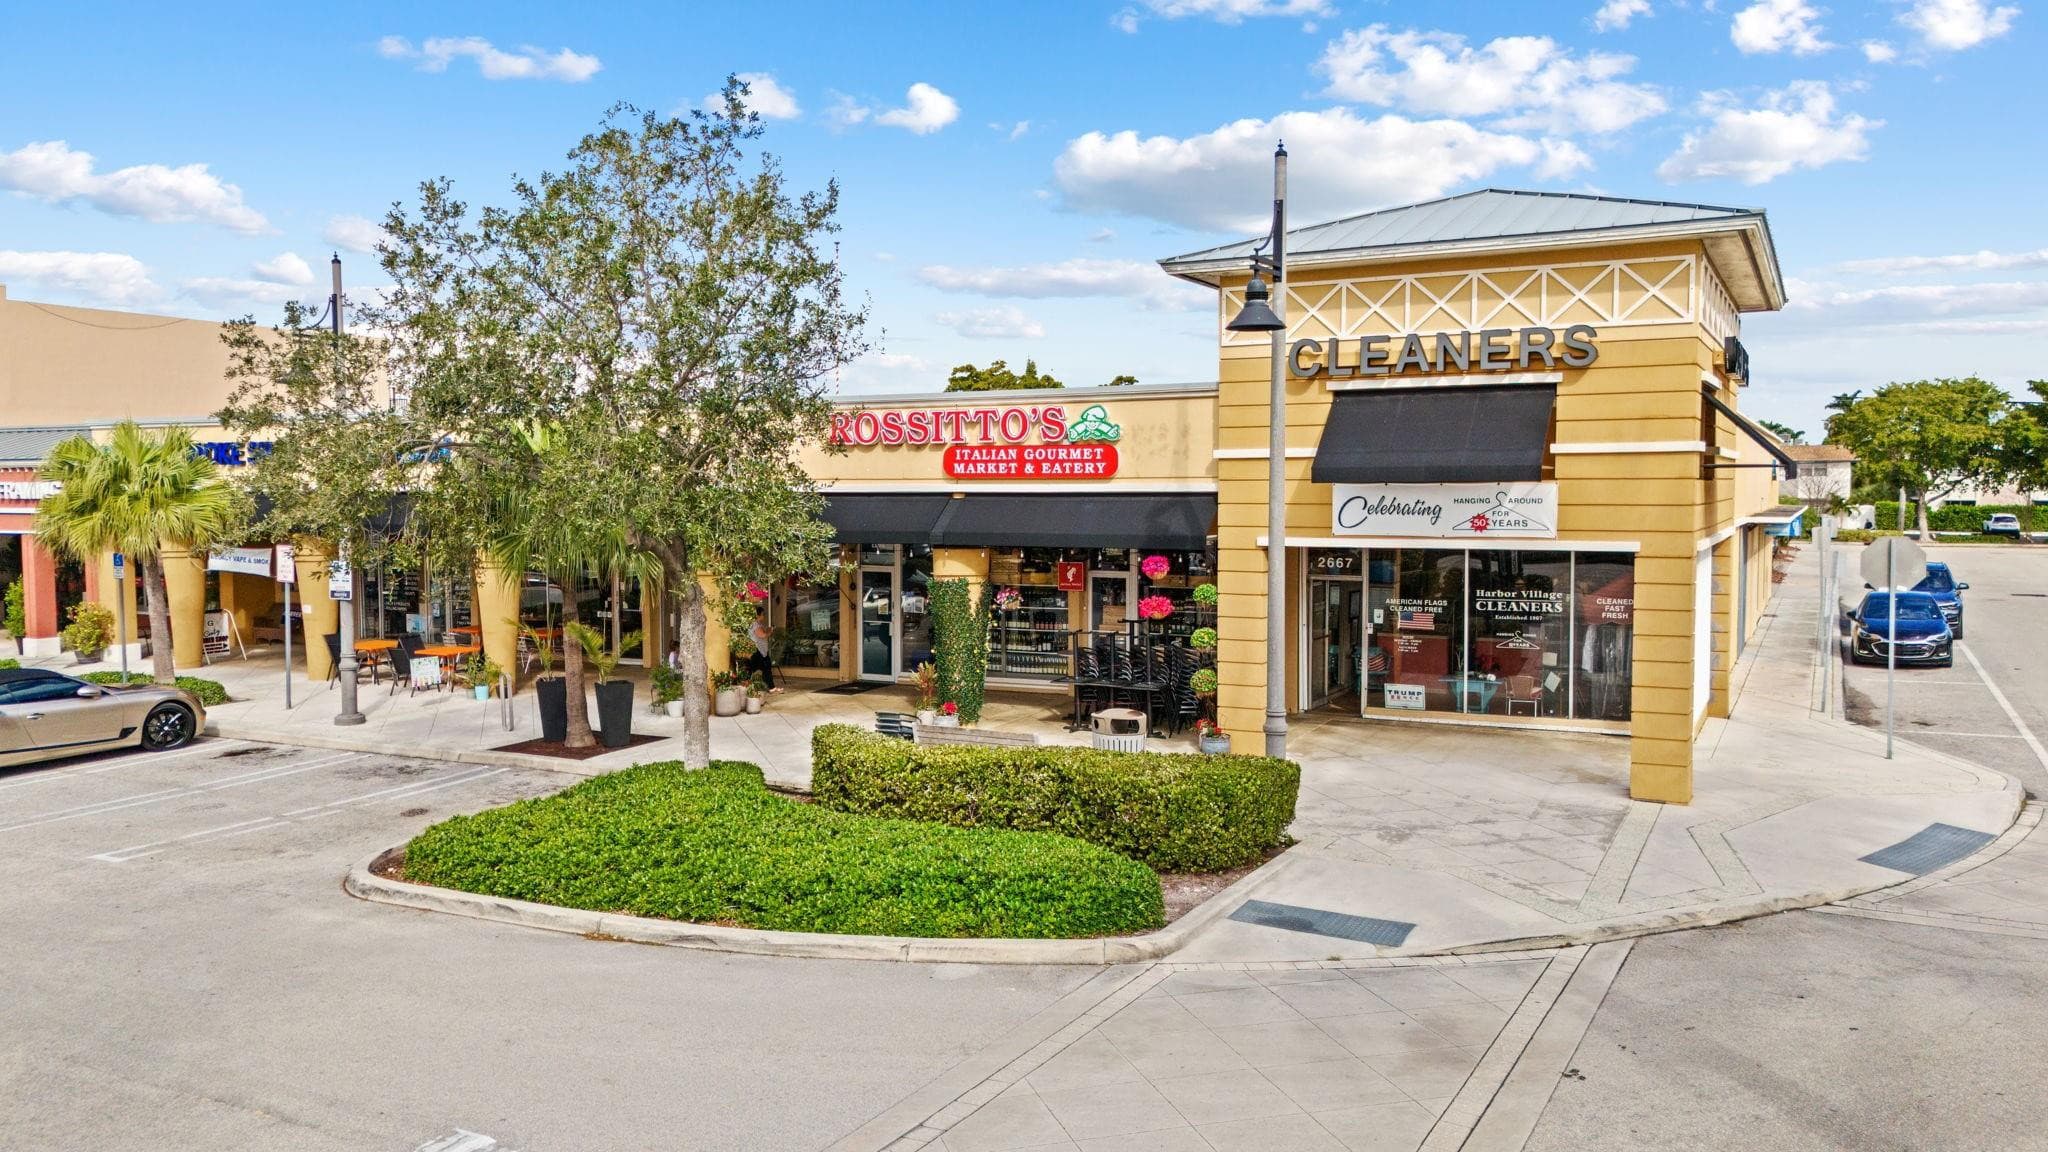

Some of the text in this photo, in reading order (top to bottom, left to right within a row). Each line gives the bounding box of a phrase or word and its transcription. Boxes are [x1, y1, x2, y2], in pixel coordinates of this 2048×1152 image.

[1289, 324, 1598, 377] CLEANERS
[829, 405, 1067, 445] ROSSITTO'S
[955, 448, 1104, 461] ITALIAN GOURMET
[953, 463, 1107, 474] MARKET & EATERY
[1453, 497, 1543, 505] HANGING AROUND
[1338, 495, 1442, 528] Celebrating
[1473, 518, 1528, 527] 50 YEARS
[1317, 557, 1353, 568] 2667
[1475, 589, 1563, 600] Harbor Village
[1475, 601, 1563, 613] CLEANERS
